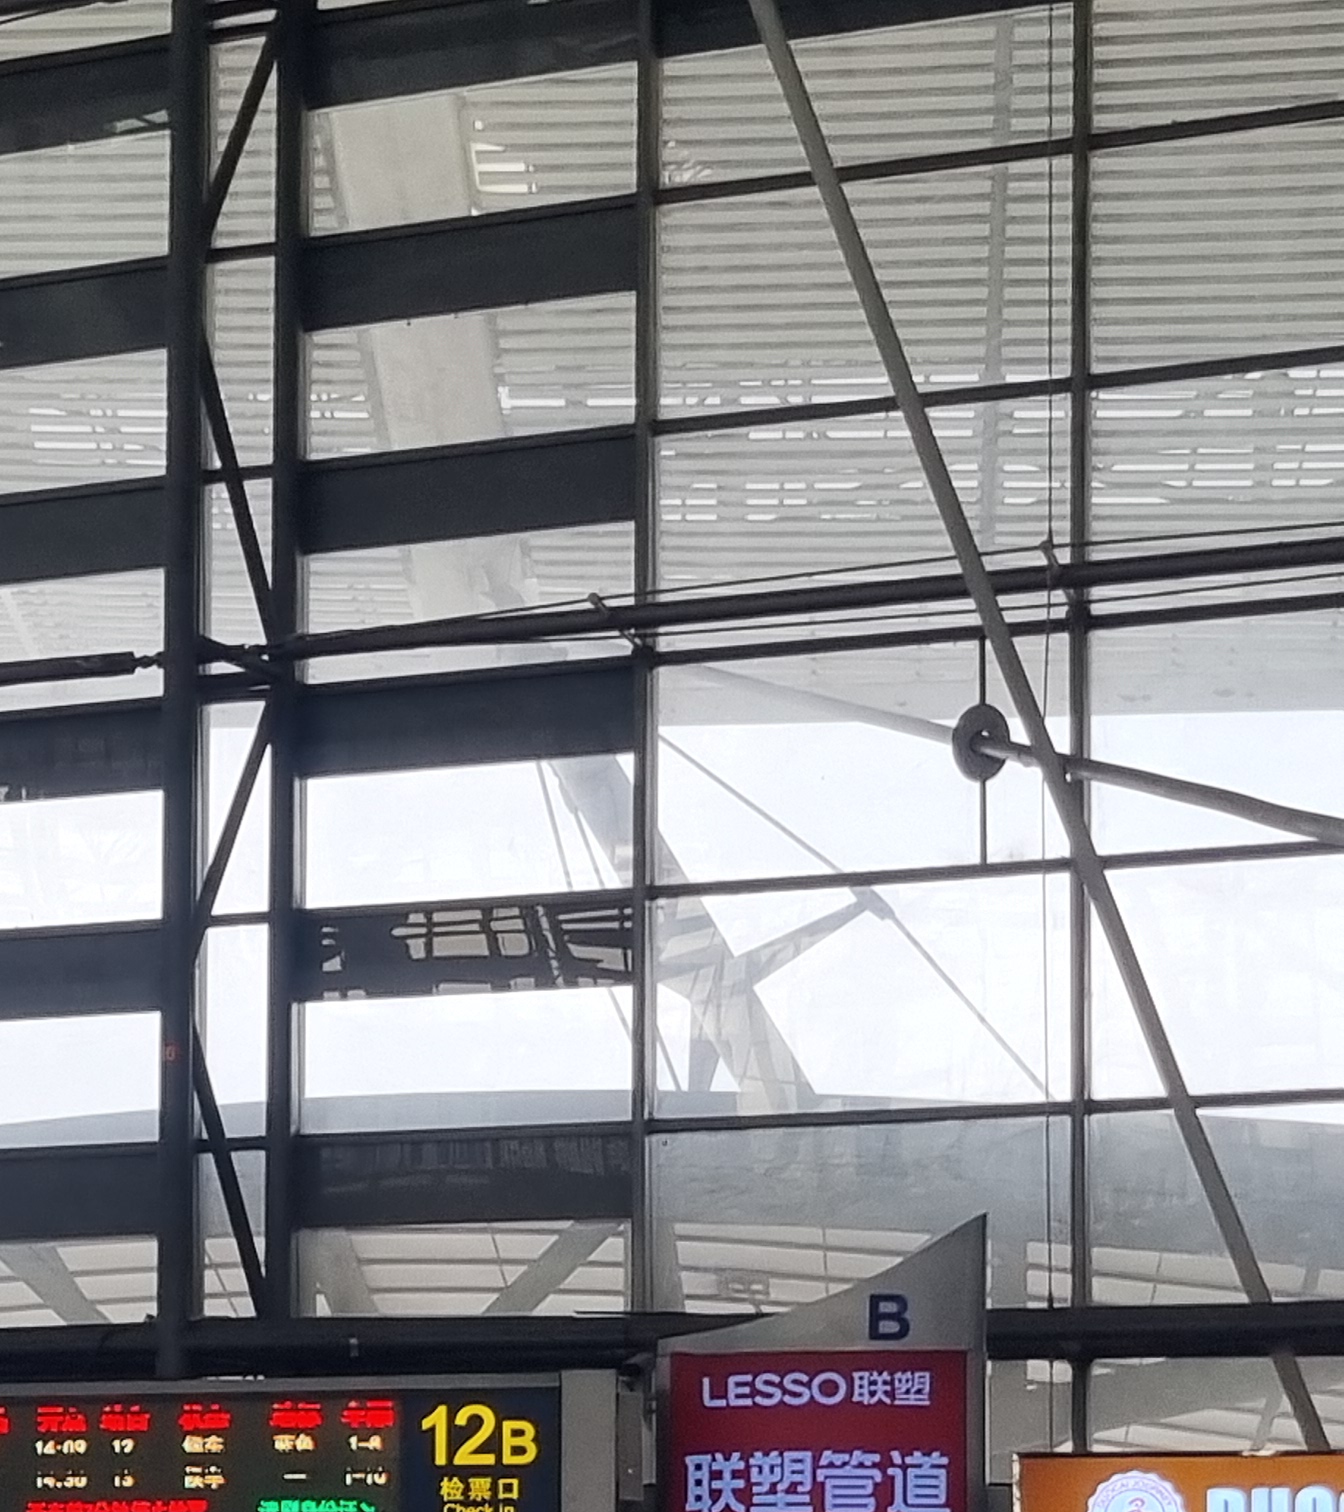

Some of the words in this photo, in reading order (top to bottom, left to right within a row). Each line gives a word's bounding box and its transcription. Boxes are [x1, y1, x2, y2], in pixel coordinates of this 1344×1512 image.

[869, 1294, 910, 1340] B
[702, 1373, 848, 1408] LESSO
[851, 1369, 931, 1406] 联塑
[420, 1403, 539, 1467] 12B
[440, 1476, 520, 1502] 检票口
